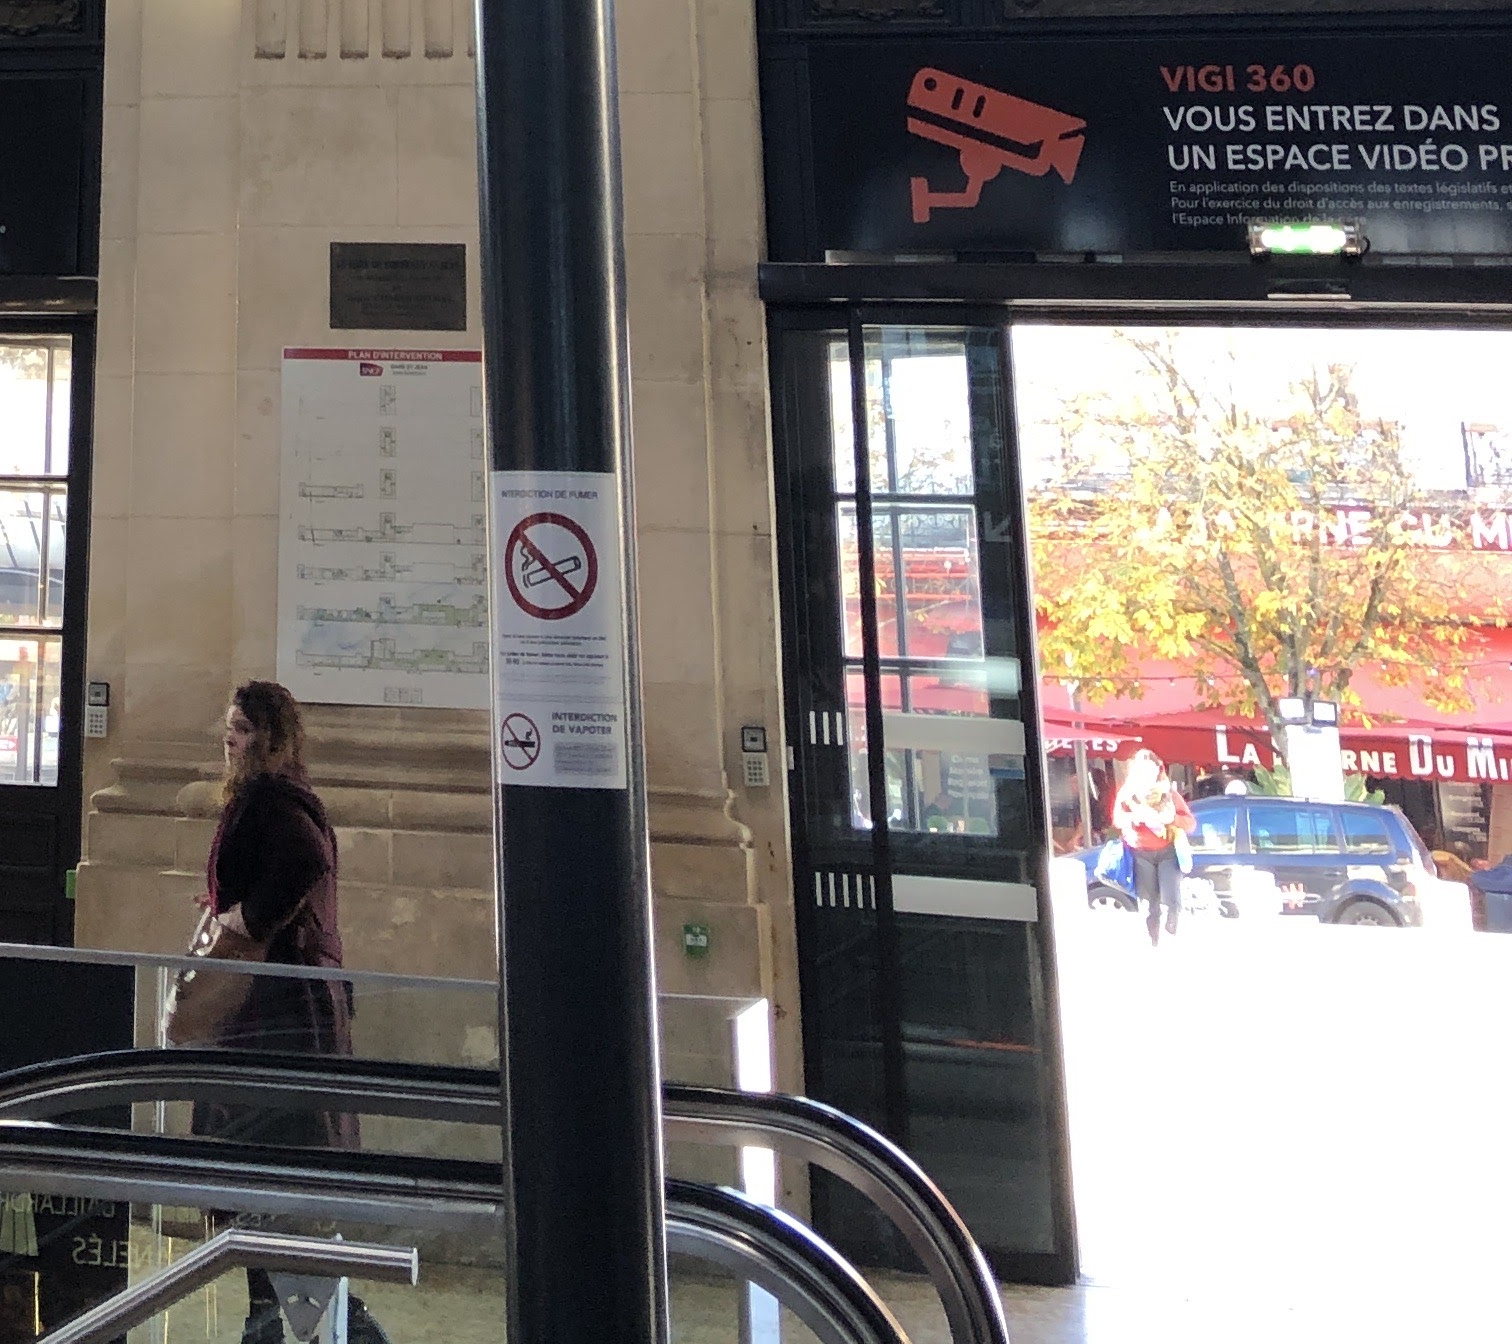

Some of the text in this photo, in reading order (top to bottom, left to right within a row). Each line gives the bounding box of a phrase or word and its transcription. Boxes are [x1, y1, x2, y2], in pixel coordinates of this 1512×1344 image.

[1160, 64, 1315, 92] VIGI 360
[1162, 104, 1500, 132] VOUS ENTREZ DANS
[1168, 144, 1216, 171] UN
[1226, 143, 1351, 171] ESPACE
[1357, 137, 1469, 171] VIDÉO
[1169, 181, 1186, 193] En
[1189, 180, 1259, 194] application
[1262, 181, 1285, 193] des
[1288, 181, 1365, 195] dispositions
[1367, 182, 1391, 193] des
[1394, 182, 1433, 194] textes
[1437, 181, 1497, 196] législatifs
[1171, 197, 1199, 208] Pour
[1202, 197, 1260, 208] l'exercice
[1263, 197, 1280, 208] du
[1284, 197, 1314, 208] droit
[1316, 197, 1364, 209] d'accès
[1367, 200, 1389, 209] aux
[1393, 198, 1503, 212] enregistrements,
[1172, 213, 1224, 226] l'Espace
[552, 712, 618, 723] INTERDICTION
[552, 724, 612, 735] DE VAPOTER
